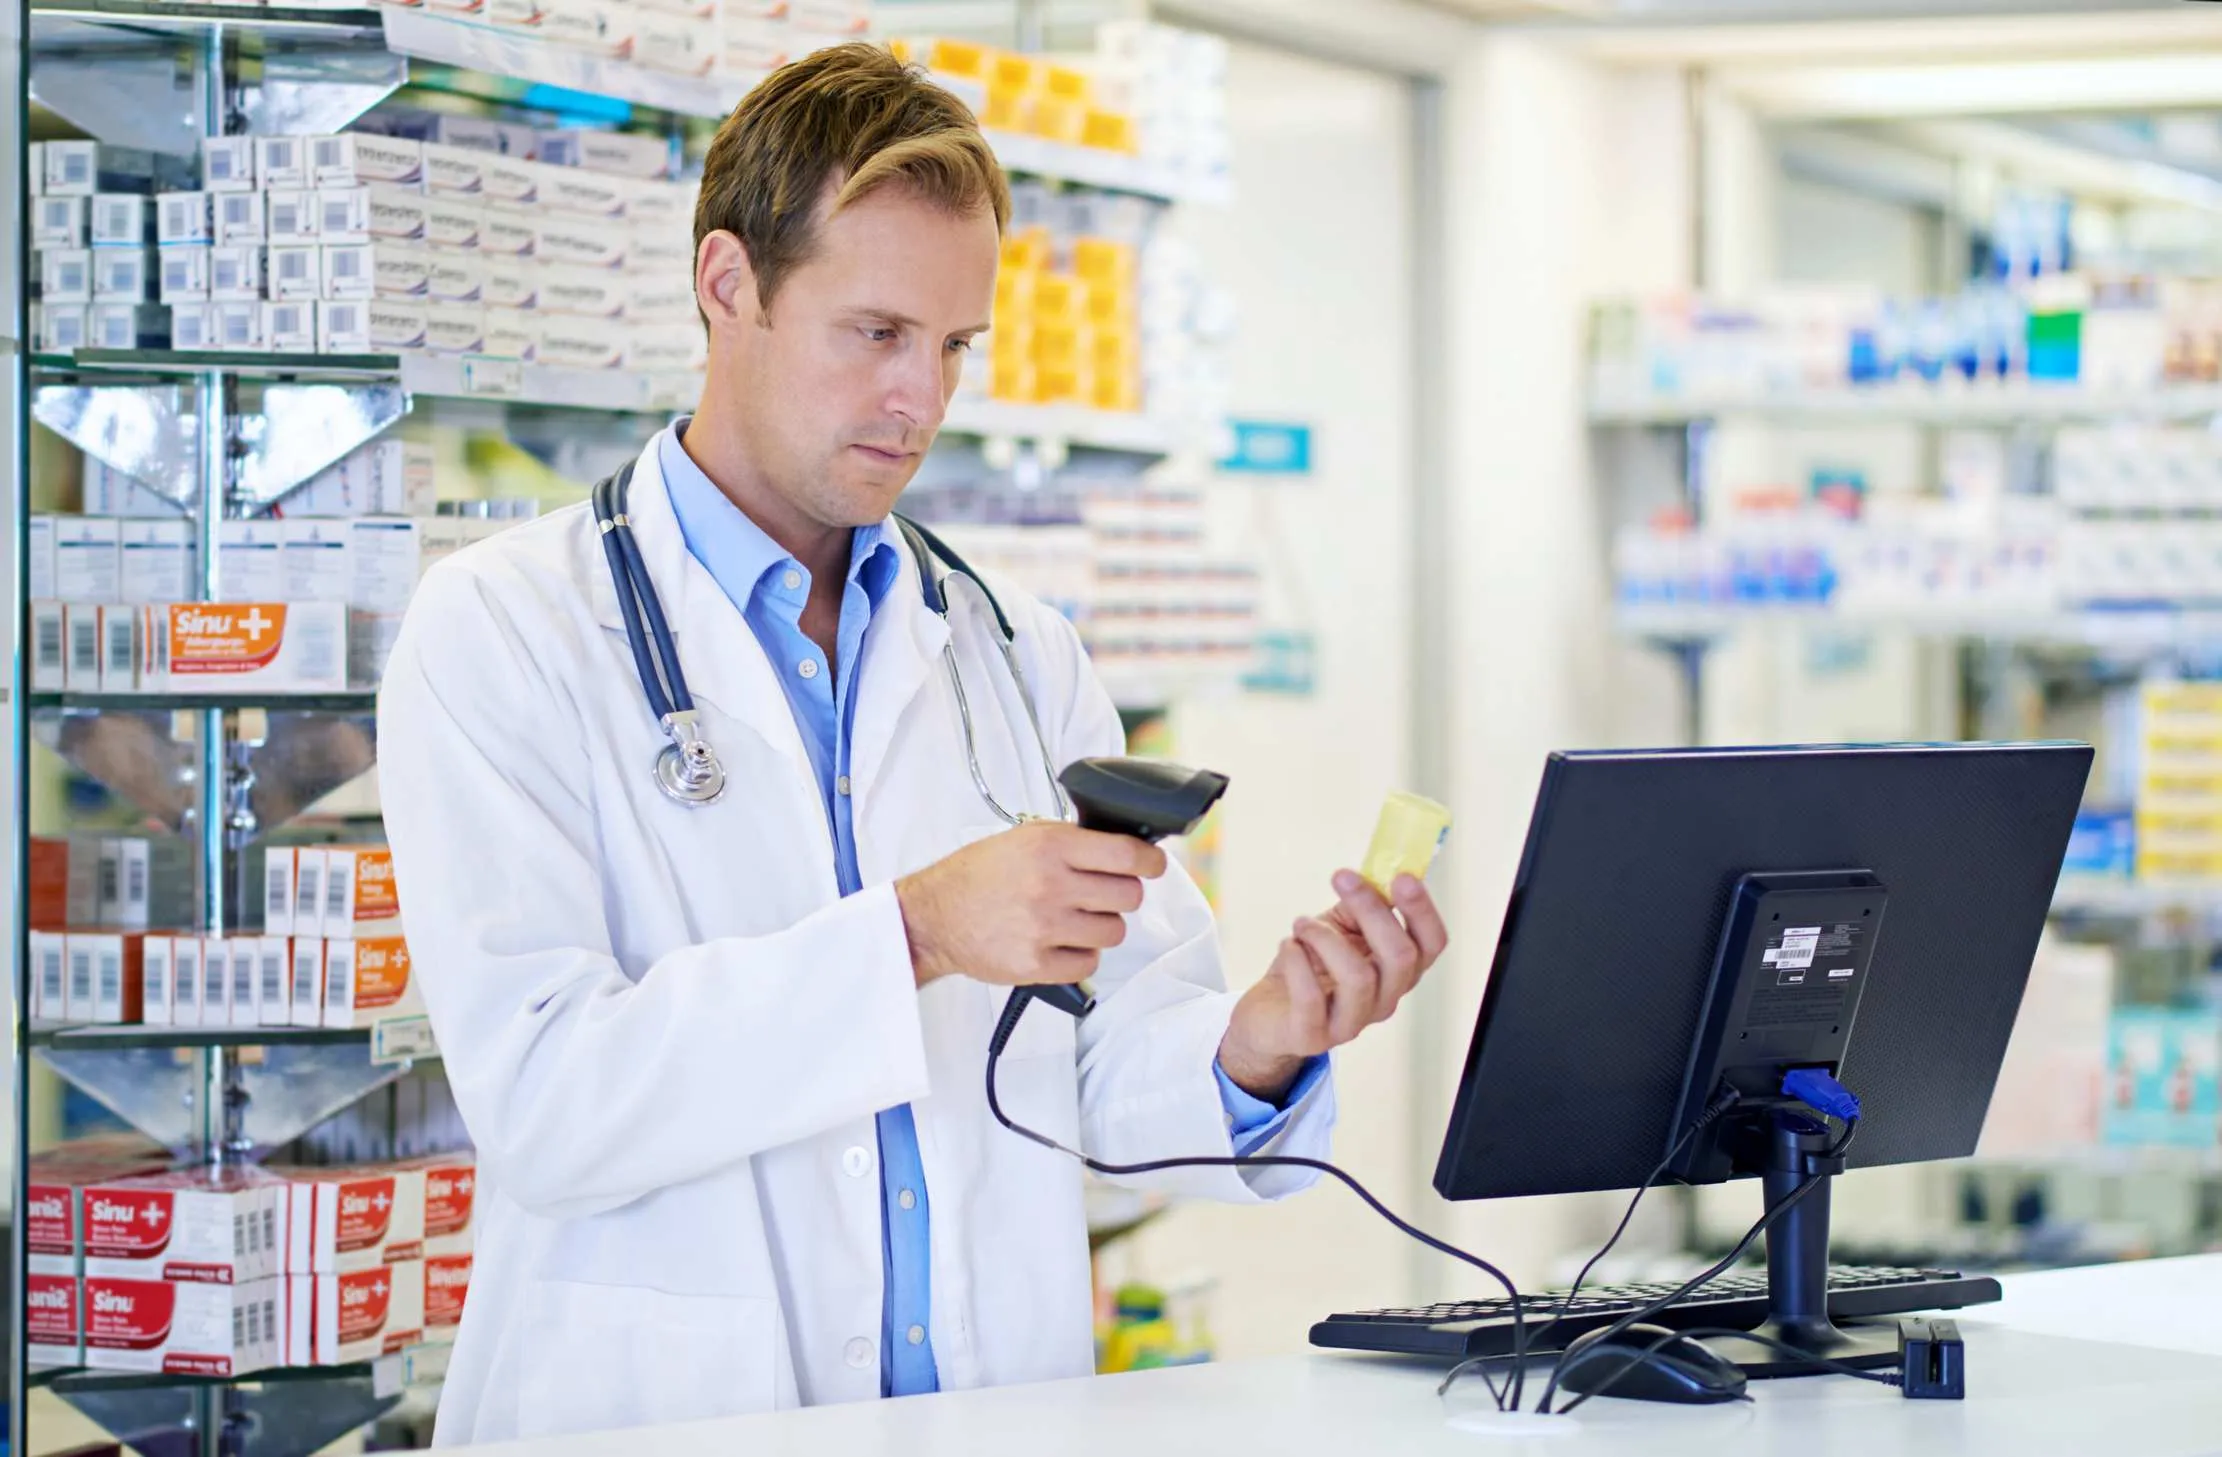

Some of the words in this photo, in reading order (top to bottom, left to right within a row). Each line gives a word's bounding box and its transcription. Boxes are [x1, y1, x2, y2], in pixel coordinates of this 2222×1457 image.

[176, 607, 233, 634] Sinu
[92, 1198, 135, 1223] Sinu
[93, 1288, 135, 1313] Sinu
